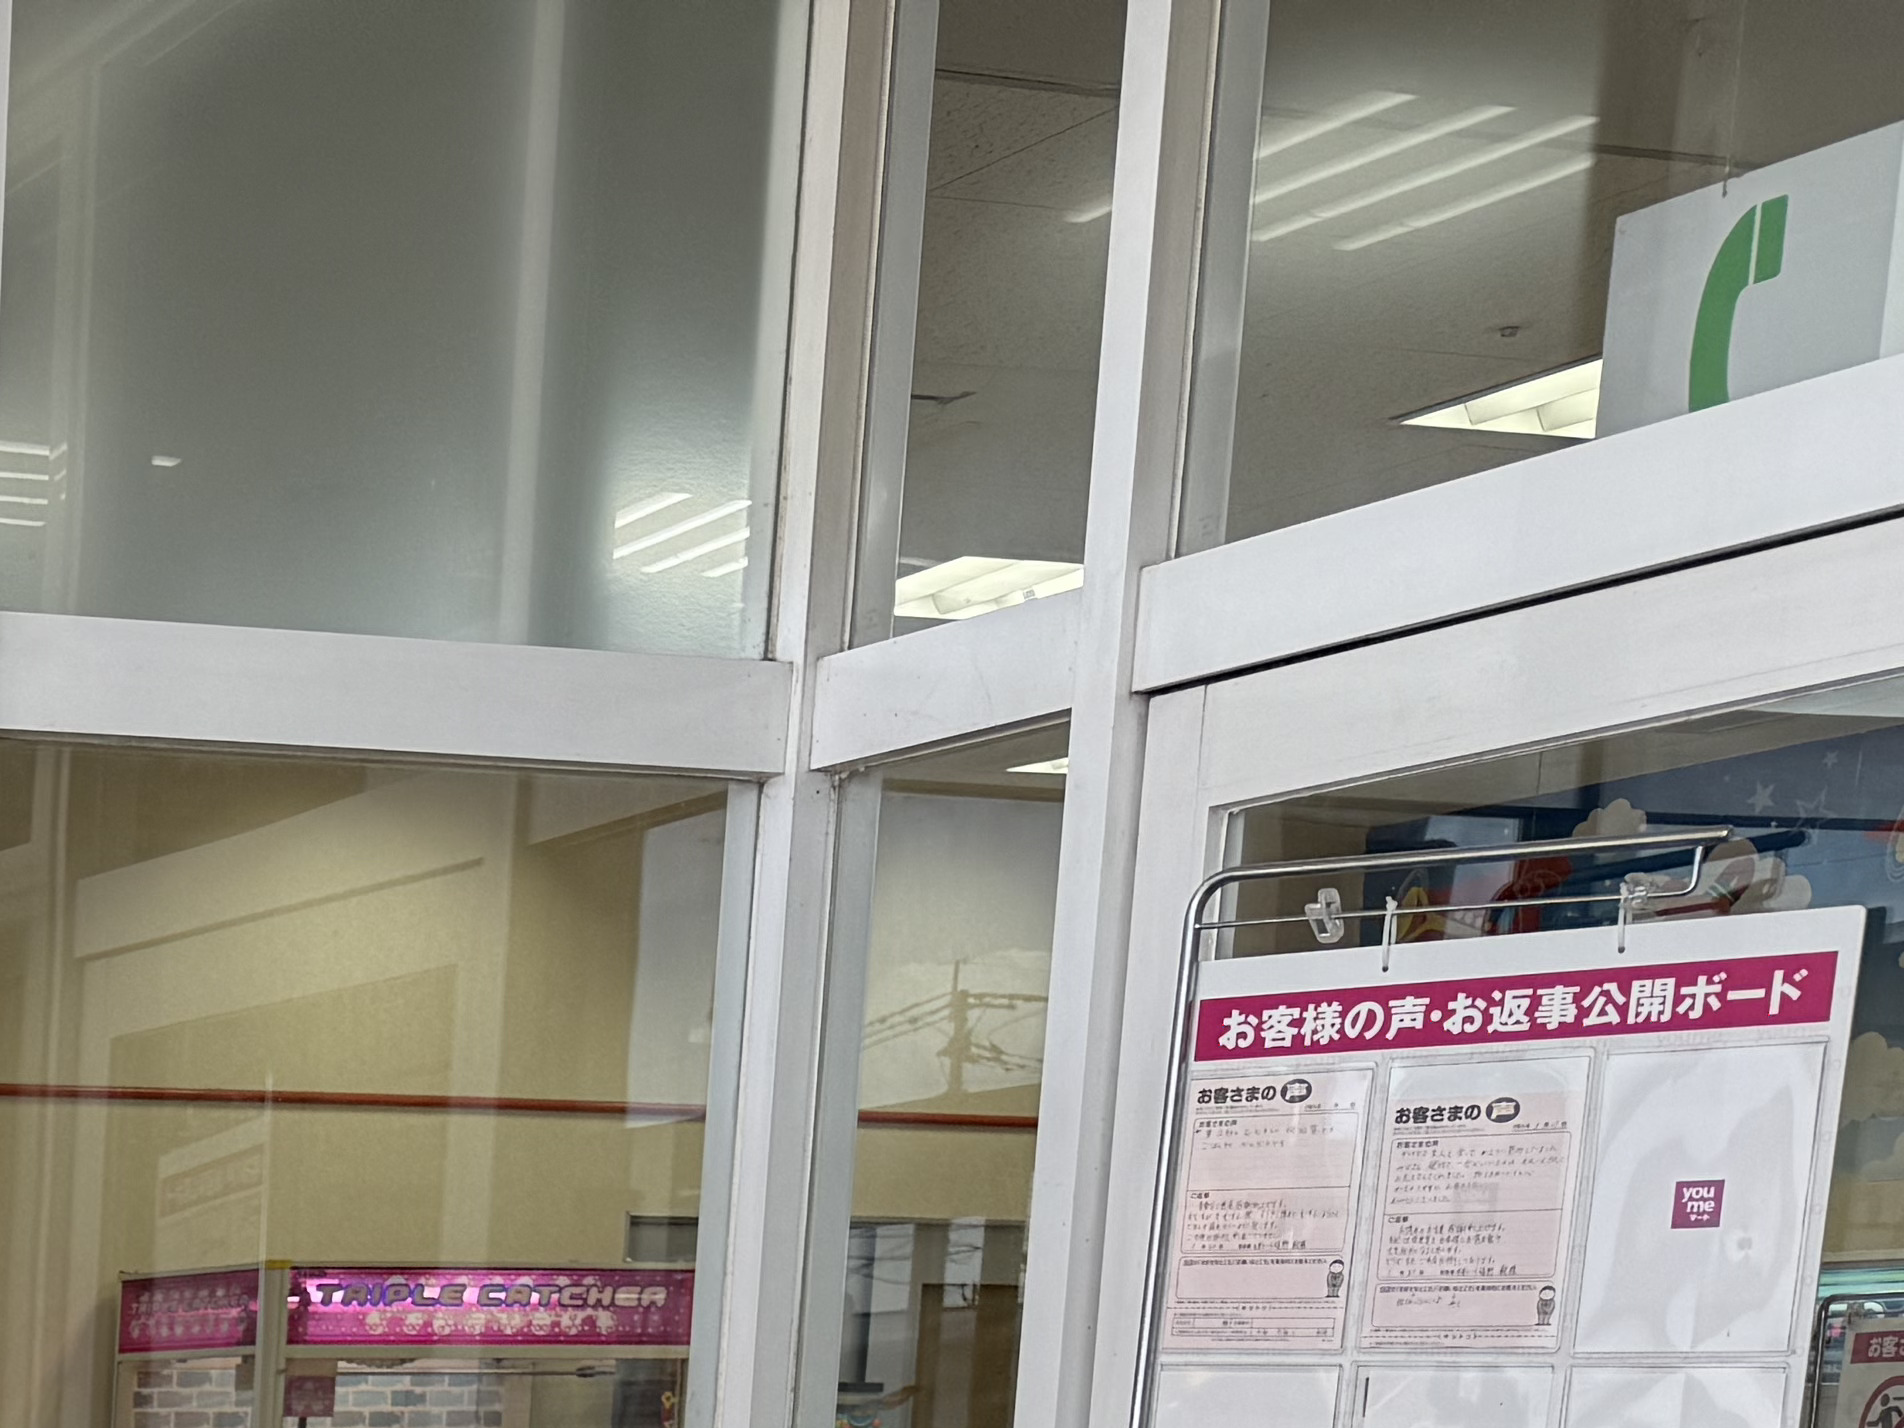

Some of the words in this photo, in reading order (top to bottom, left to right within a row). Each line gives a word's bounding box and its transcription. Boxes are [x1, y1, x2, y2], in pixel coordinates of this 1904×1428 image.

[1218, 966, 1811, 1051] お客様の声・お返事公開ボード
[1197, 1085, 1277, 1105] お客さまの
[1394, 1104, 1482, 1125] お客さまの
[1682, 1186, 1715, 1203] you
[1686, 1200, 1715, 1213] me
[314, 1281, 470, 1309] TRIPLE
[477, 1283, 668, 1308] CATCHER
